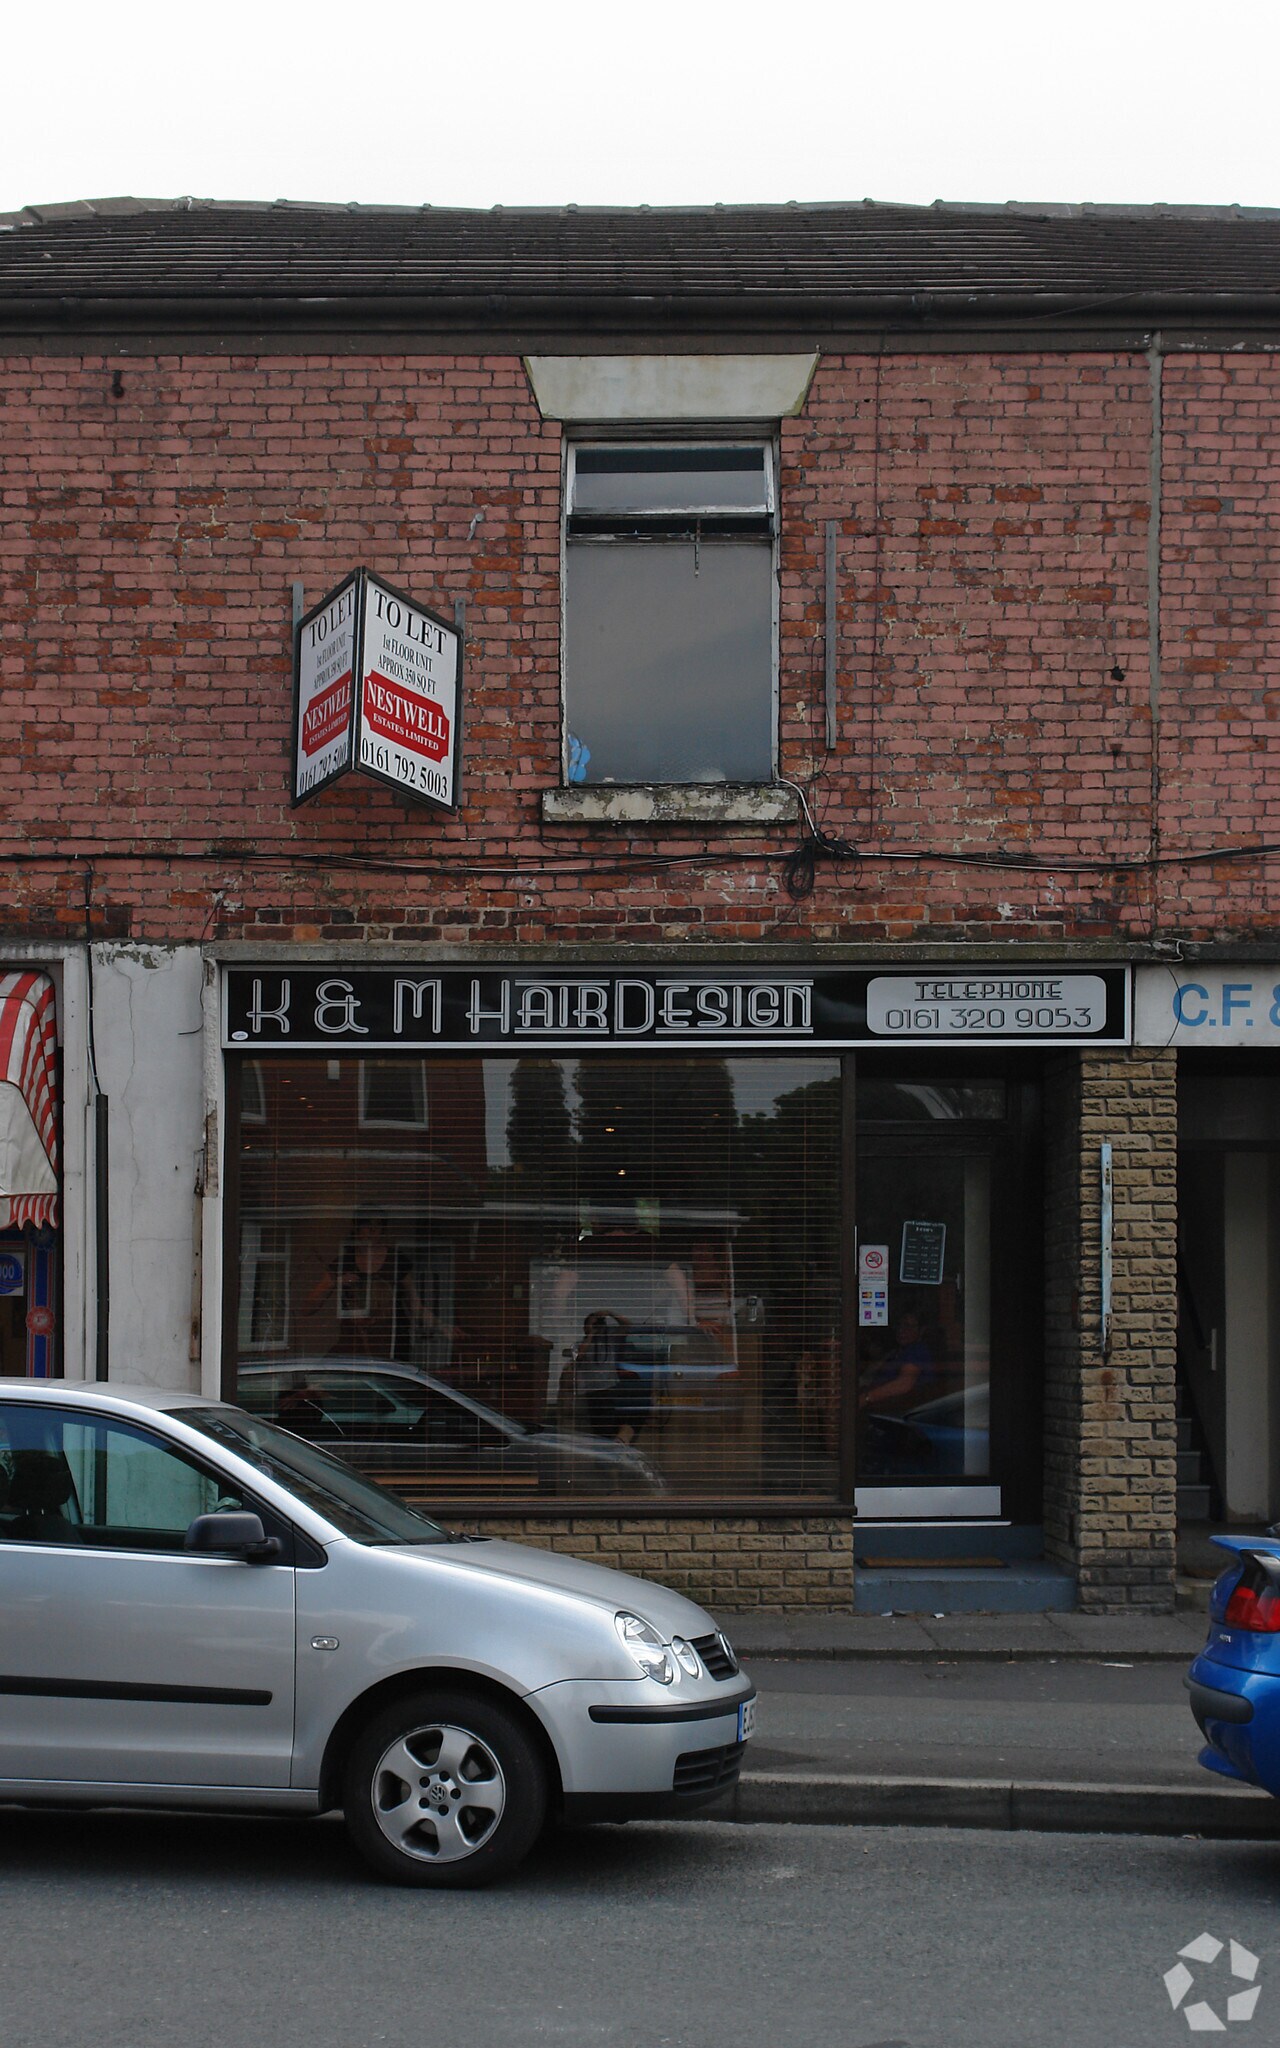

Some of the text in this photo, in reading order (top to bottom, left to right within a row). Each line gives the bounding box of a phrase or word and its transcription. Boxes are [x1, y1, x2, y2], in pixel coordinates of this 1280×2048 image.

[309, 589, 354, 648] TO LET
[375, 589, 447, 655] TO LET
[378, 654, 436, 695] APPROX 350 SQ FT
[383, 634, 433, 673] 1st FLOOR UNIT
[305, 680, 351, 735] NESTWELL
[367, 679, 446, 740] NESTWELL
[373, 712, 439, 751] ESTATES LIMITED
[362, 737, 447, 798] 0161 792 5003
[246, 978, 291, 1034] K
[314, 978, 369, 1034] &
[394, 978, 442, 1034] M
[914, 980, 1062, 1001] TELEPHONE
[1172, 983, 1253, 1028] C.F.
[885, 1007, 1092, 1029] 0161 320 9053
[0, 1264, 15, 1281] 00
